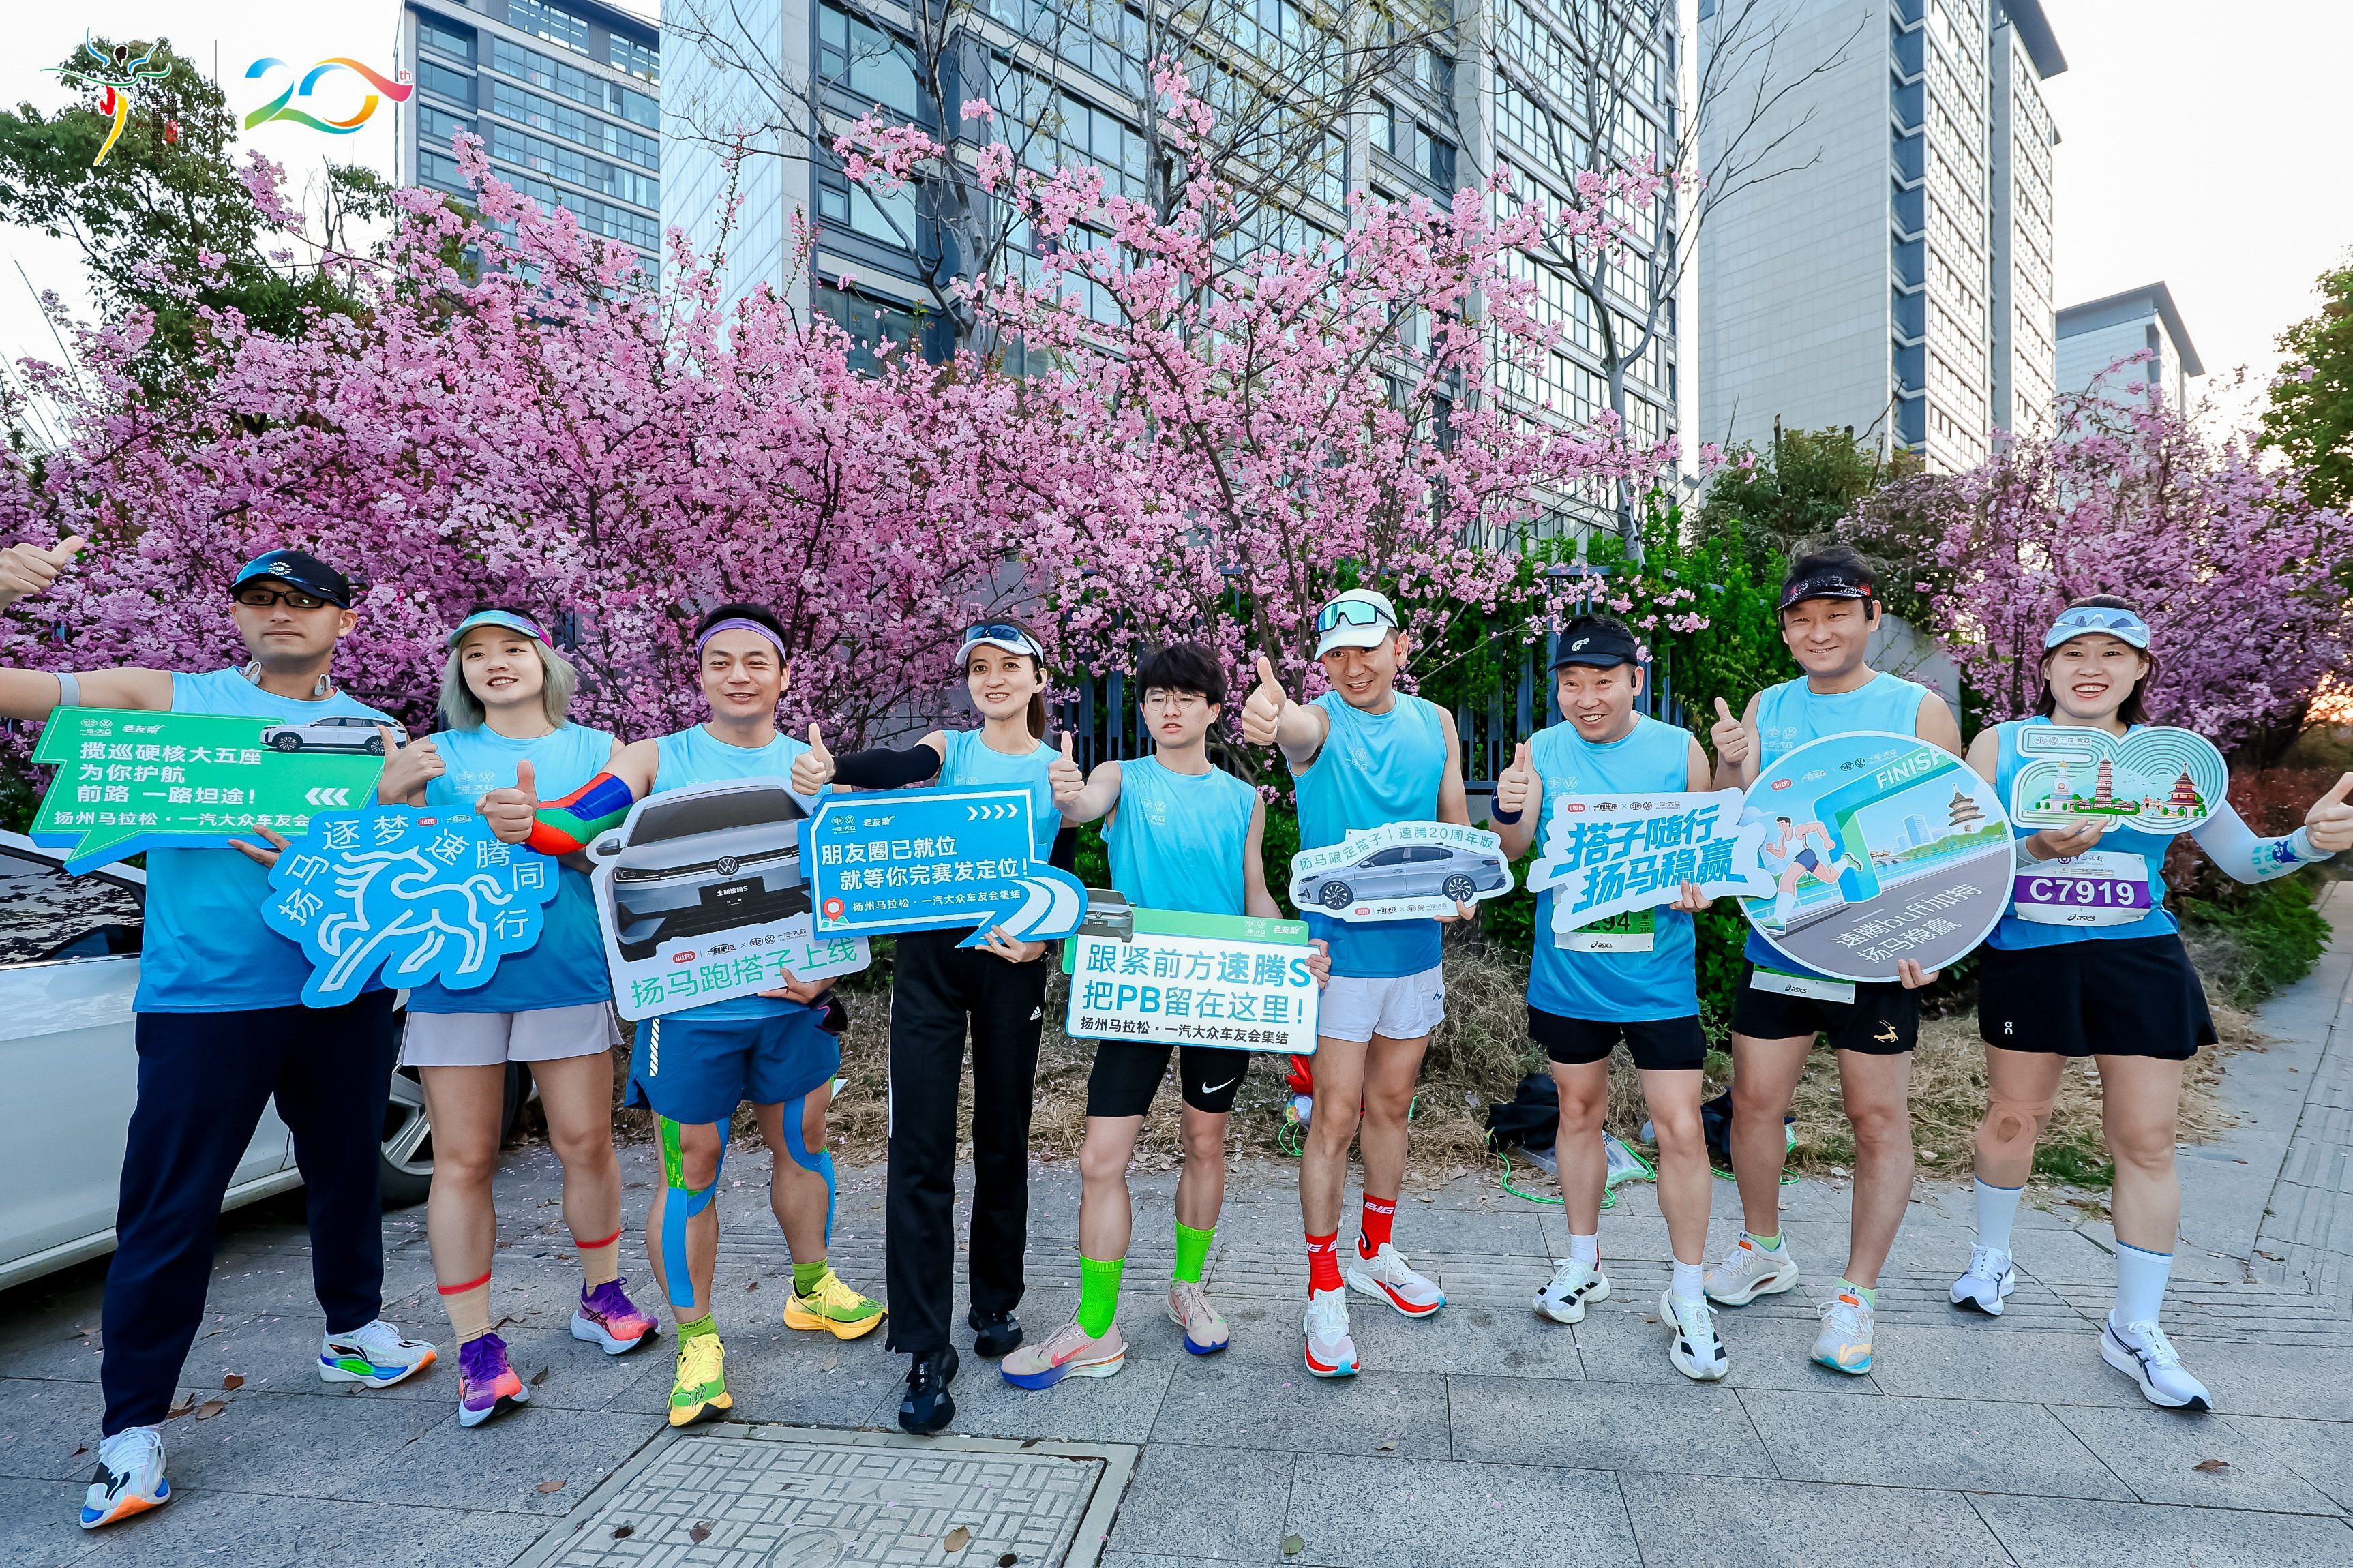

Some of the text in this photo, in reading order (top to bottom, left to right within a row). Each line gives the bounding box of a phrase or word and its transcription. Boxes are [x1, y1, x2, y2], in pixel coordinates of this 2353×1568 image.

[80, 741, 263, 765] 揽巡硬核大五座
[78, 764, 185, 783] 为你护航
[76, 785, 130, 804] 前路
[821, 835, 958, 866] 朋友圈已就位
[1298, 826, 1495, 871] 扬马限定搭子 速腾20周年版
[1548, 804, 1720, 879] 搭子随行
[839, 858, 1028, 890] 就等你完赛发定位！
[1571, 836, 1749, 914] 扬马稳赢
[716, 886, 749, 896] 全新速腾S
[2030, 878, 2135, 905] C7919
[1830, 884, 1983, 948] 速腾buff加持
[1857, 916, 1964, 964] 扬马稳赢
[629, 936, 858, 1009] 扬马跑搭子上线
[1085, 944, 1311, 988] 跟紧前方速腾S
[1790, 986, 1808, 994] asics
[1364, 1201, 1395, 1215] BIG
